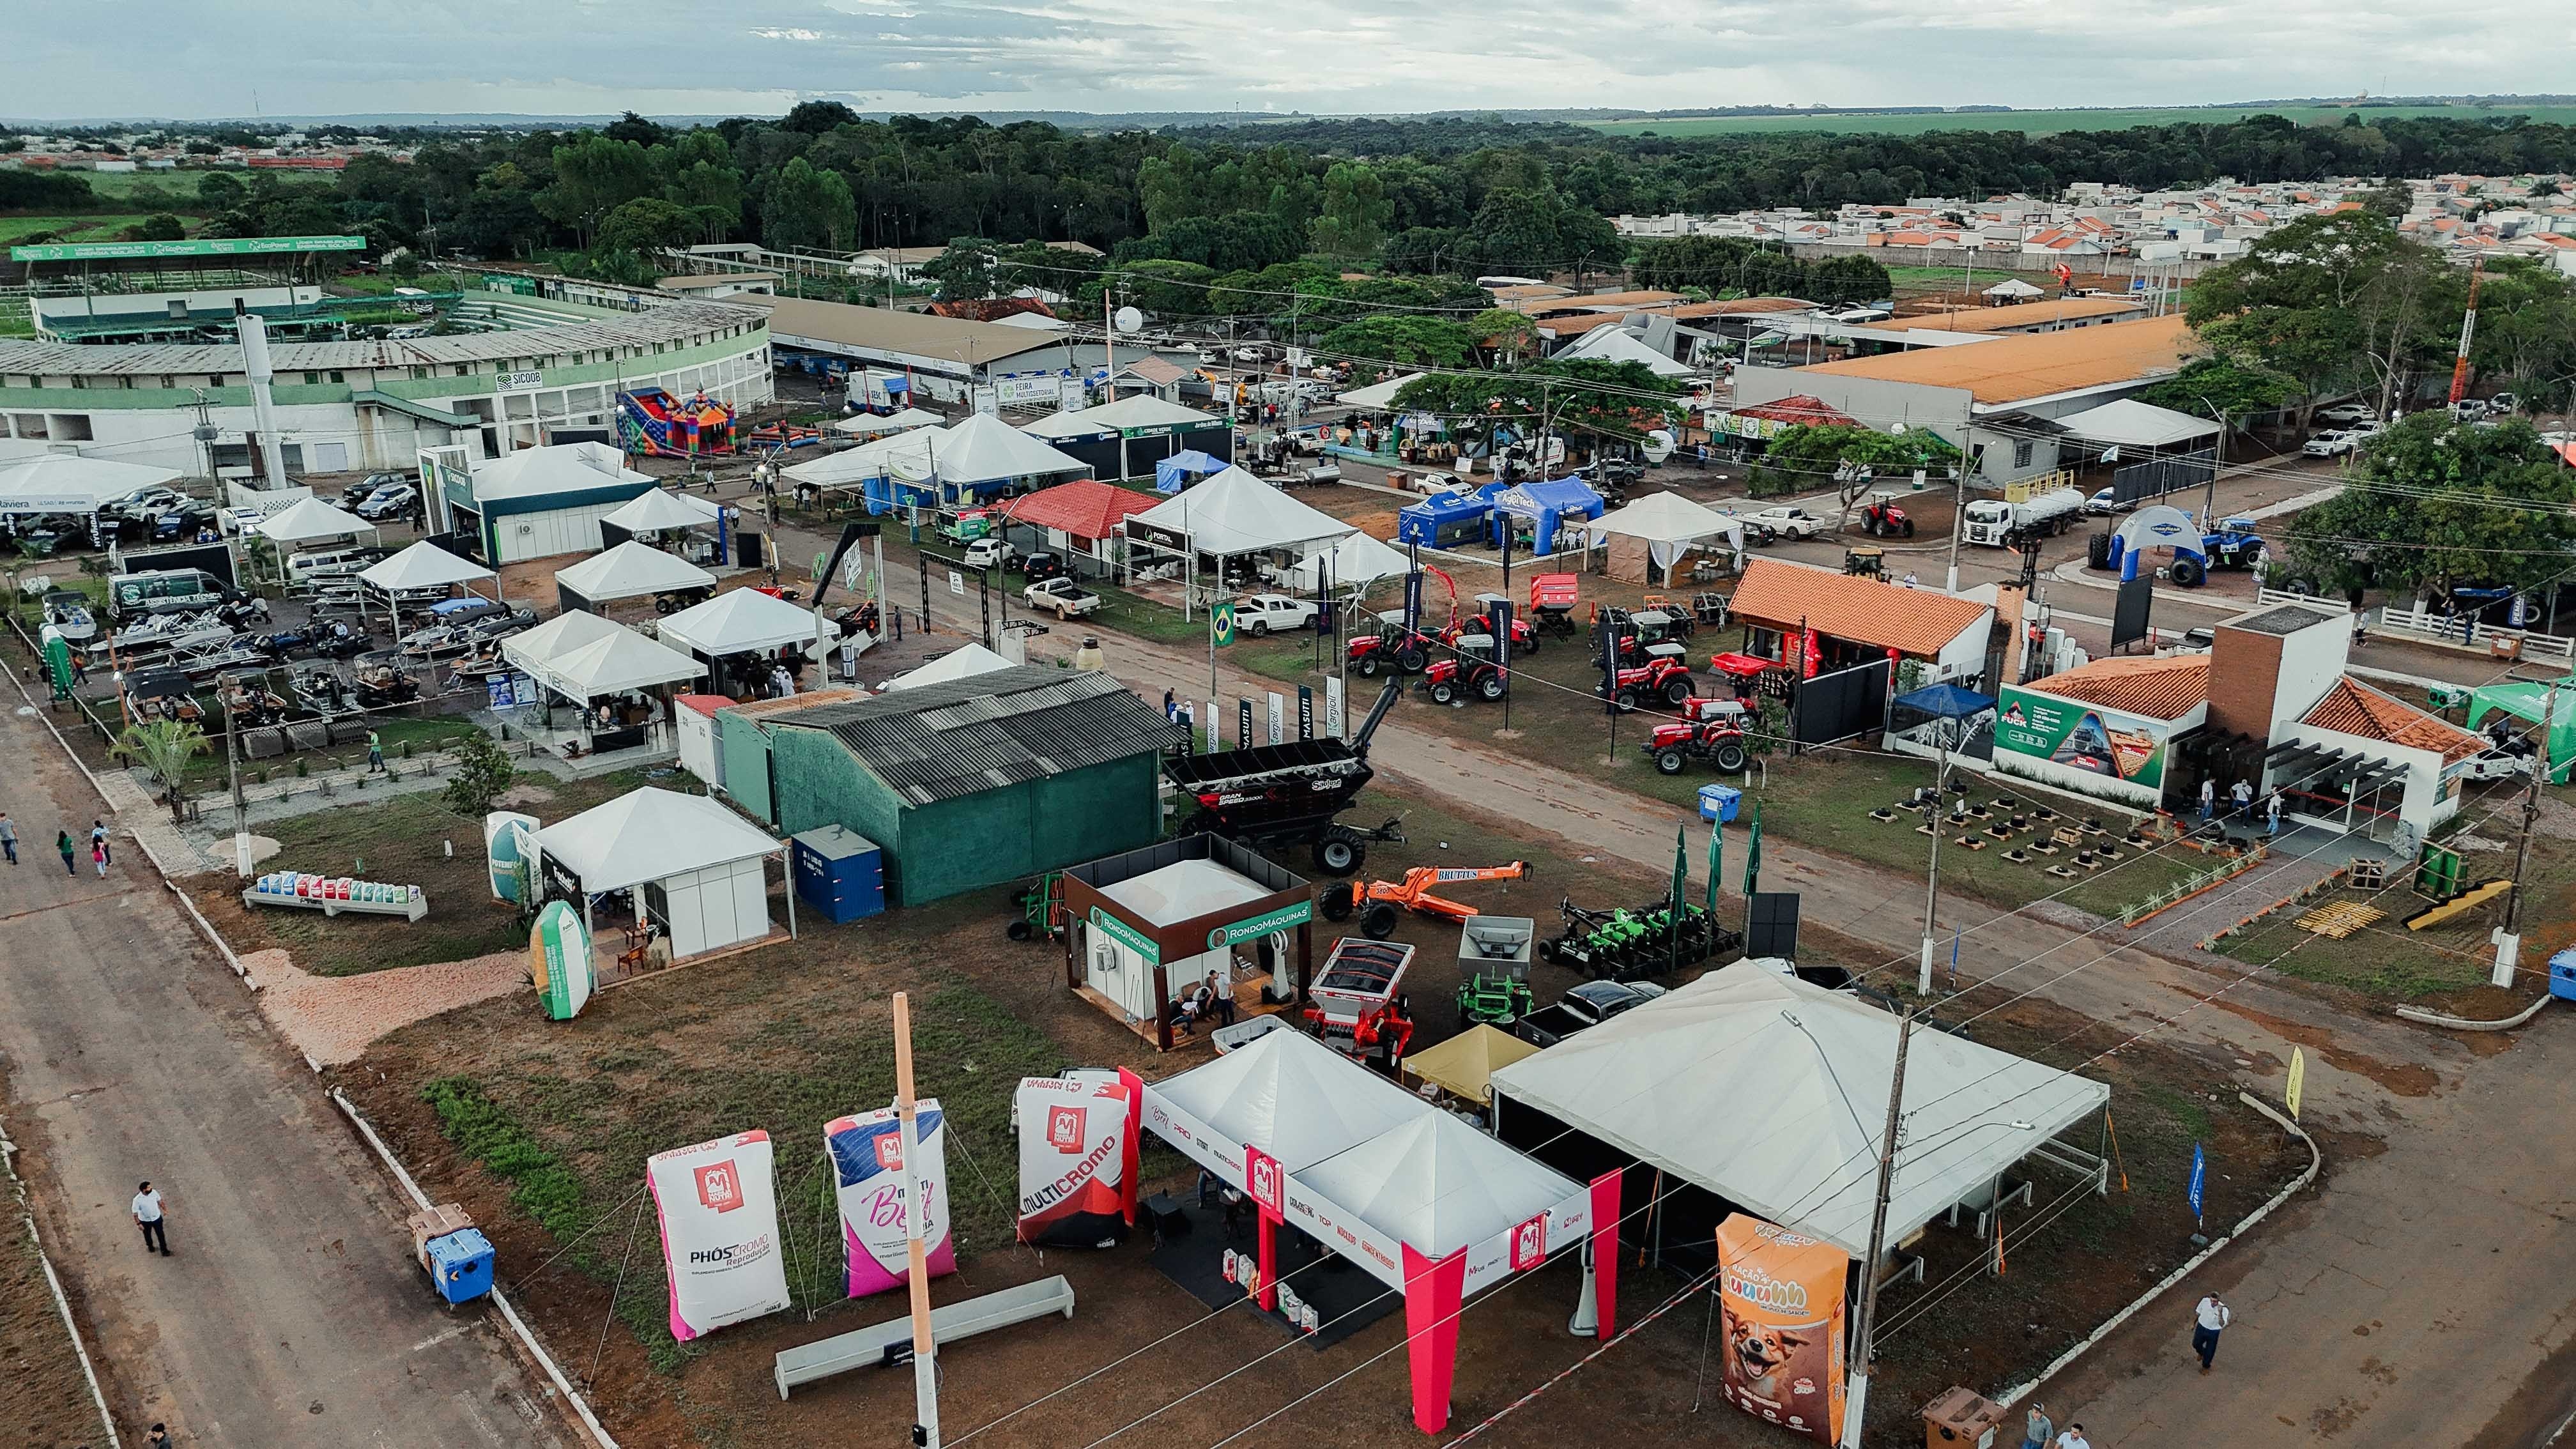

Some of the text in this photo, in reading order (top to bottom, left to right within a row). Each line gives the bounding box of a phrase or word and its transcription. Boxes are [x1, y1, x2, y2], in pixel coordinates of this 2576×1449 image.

[513, 372, 541, 384] SICOOB
[1016, 382, 1033, 391] FEIRA
[1016, 388, 1055, 399] MULTISSETORIAL
[2000, 715, 2027, 728] FUCK
[1438, 870, 1477, 881] BRUTTUS
[1022, 1135, 1116, 1215] MULTICROMO
[1319, 1214, 1331, 1227] TOP
[690, 1233, 769, 1264] PHÓSCROMO
[726, 1243, 770, 1267] Reprodução
[1732, 1264, 1758, 1282] RAÇÃO
